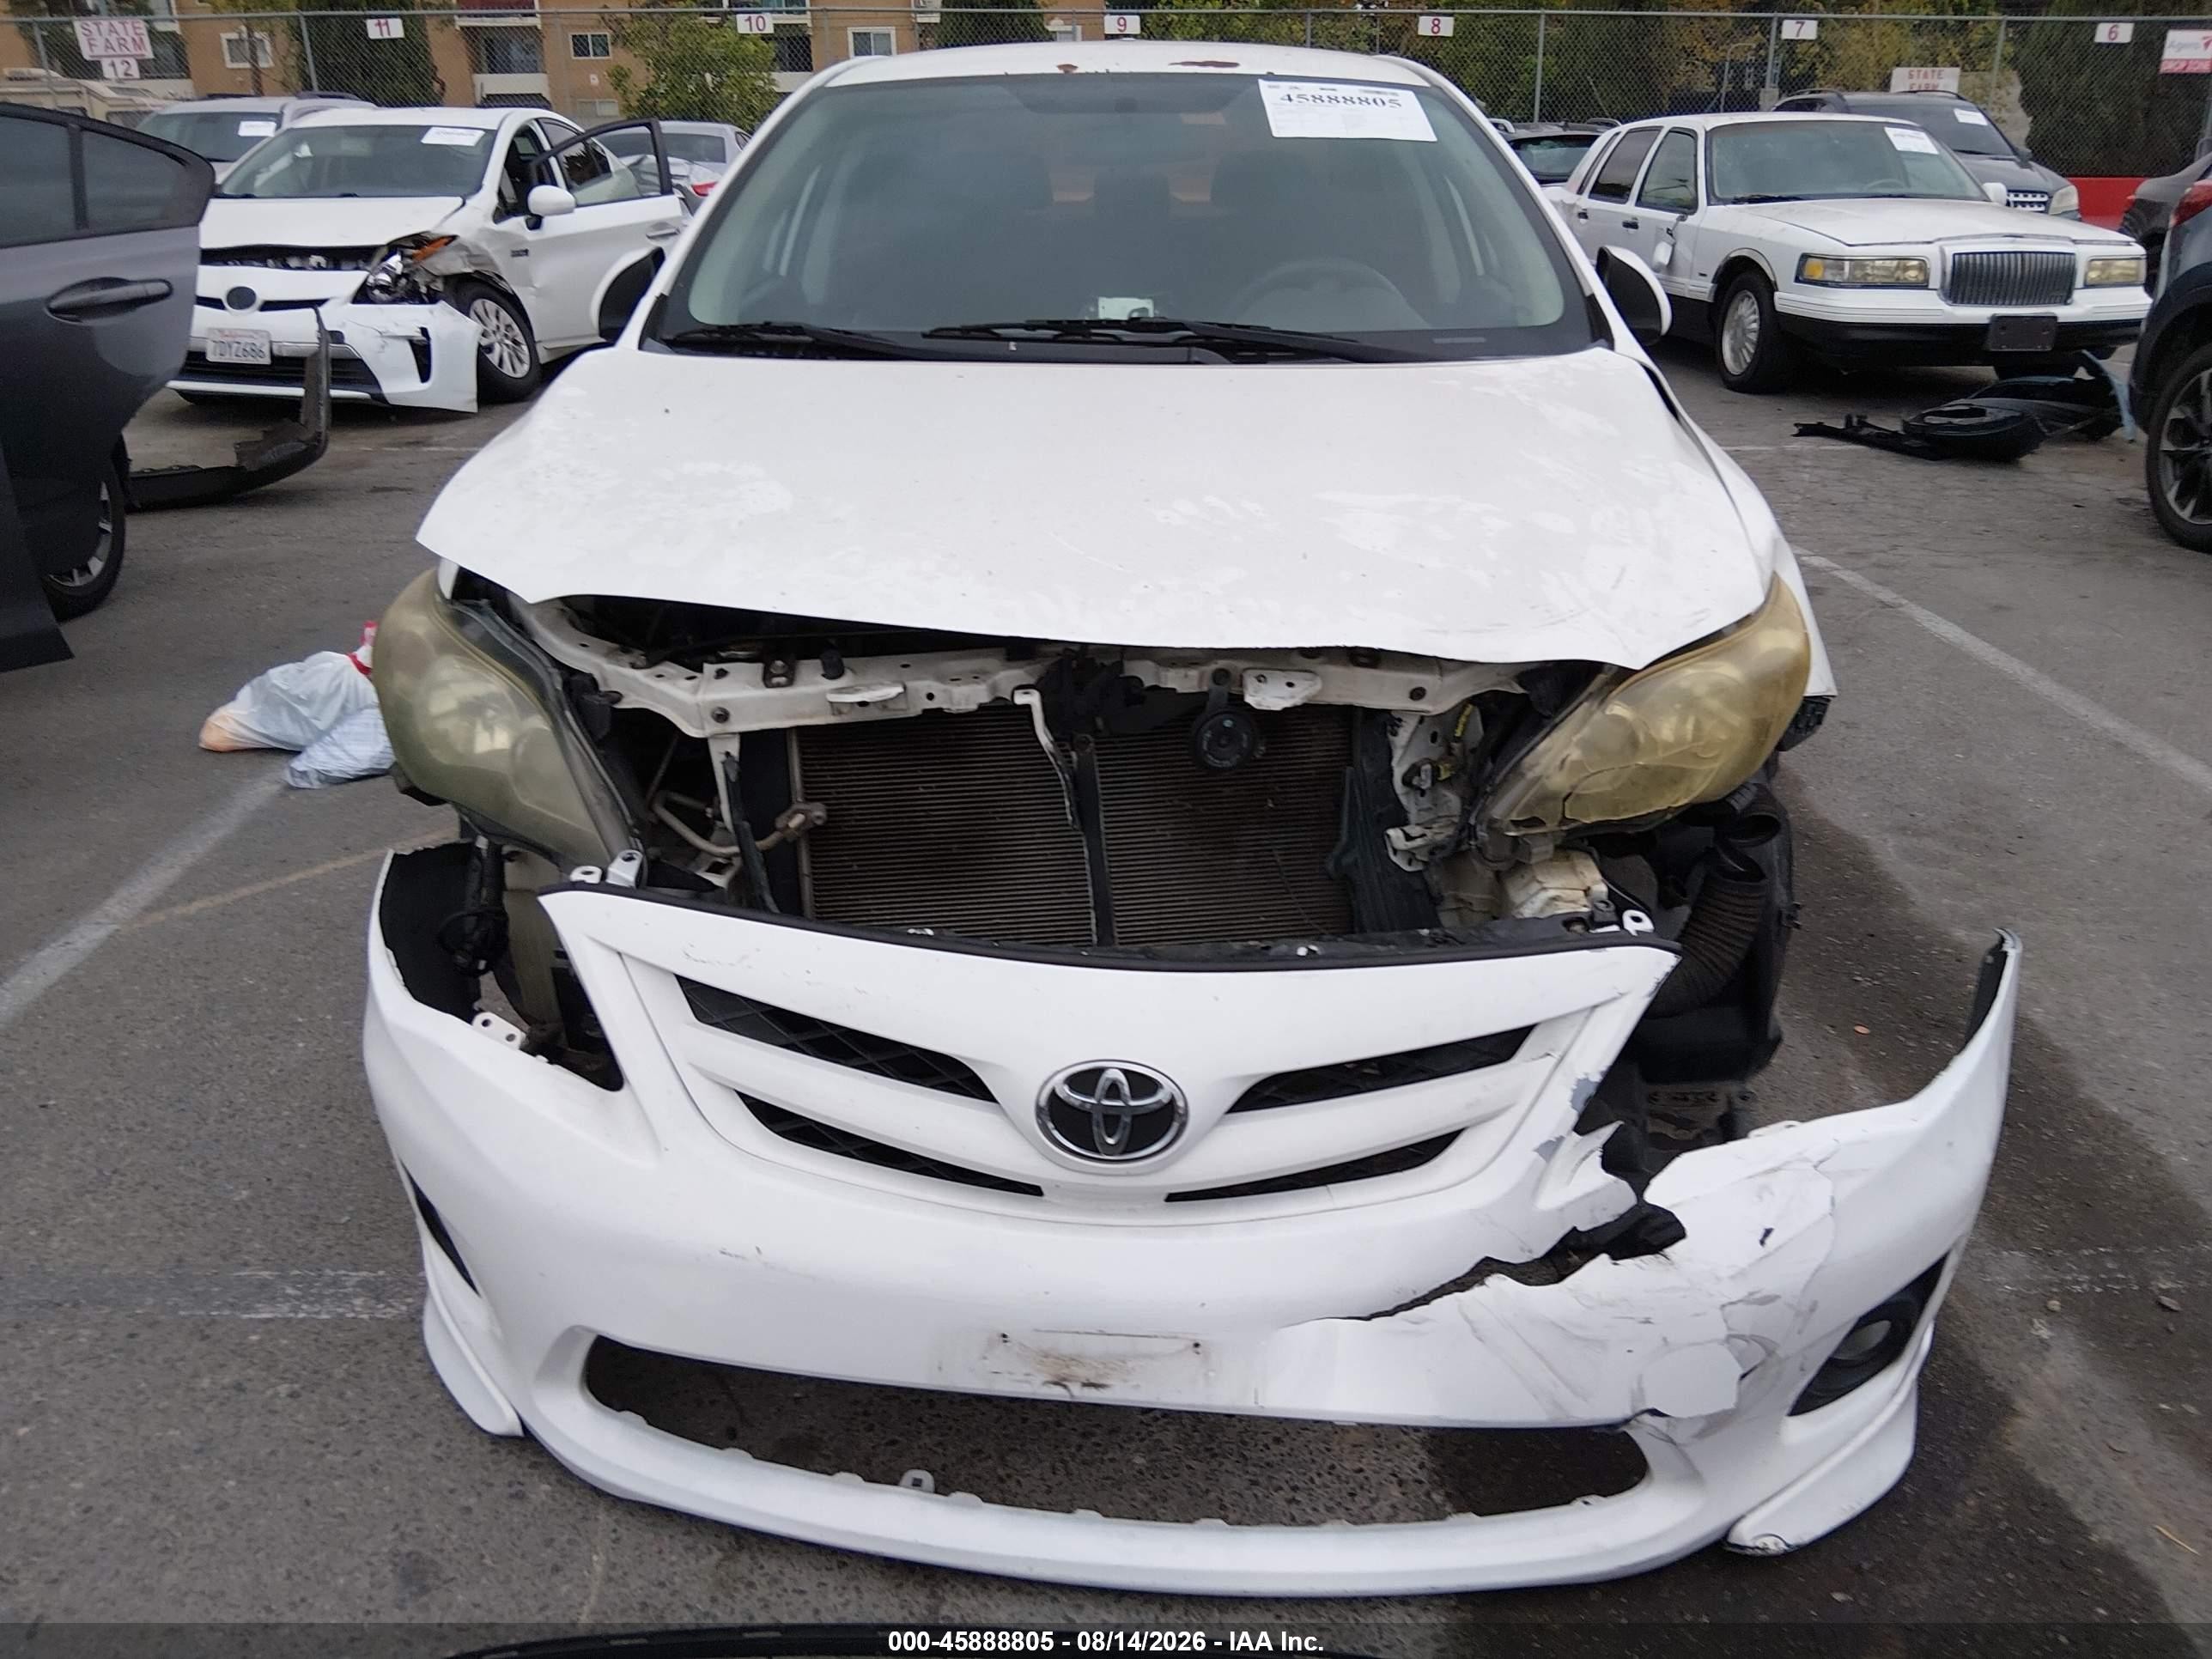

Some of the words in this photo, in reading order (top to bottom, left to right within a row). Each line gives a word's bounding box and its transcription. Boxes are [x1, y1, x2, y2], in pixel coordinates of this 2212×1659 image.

[81, 21, 144, 36] STATE
[374, 19, 391, 36] 11
[744, 15, 766, 32] 10
[1117, 16, 1127, 33] 9
[1431, 18, 1440, 34] 8
[1796, 21, 1806, 37] 7
[2108, 24, 2118, 40] 6
[87, 36, 148, 52] FARM
[108, 59, 134, 77] 12
[1908, 70, 1945, 80] STATE
[1280, 94, 1402, 109] 45888805
